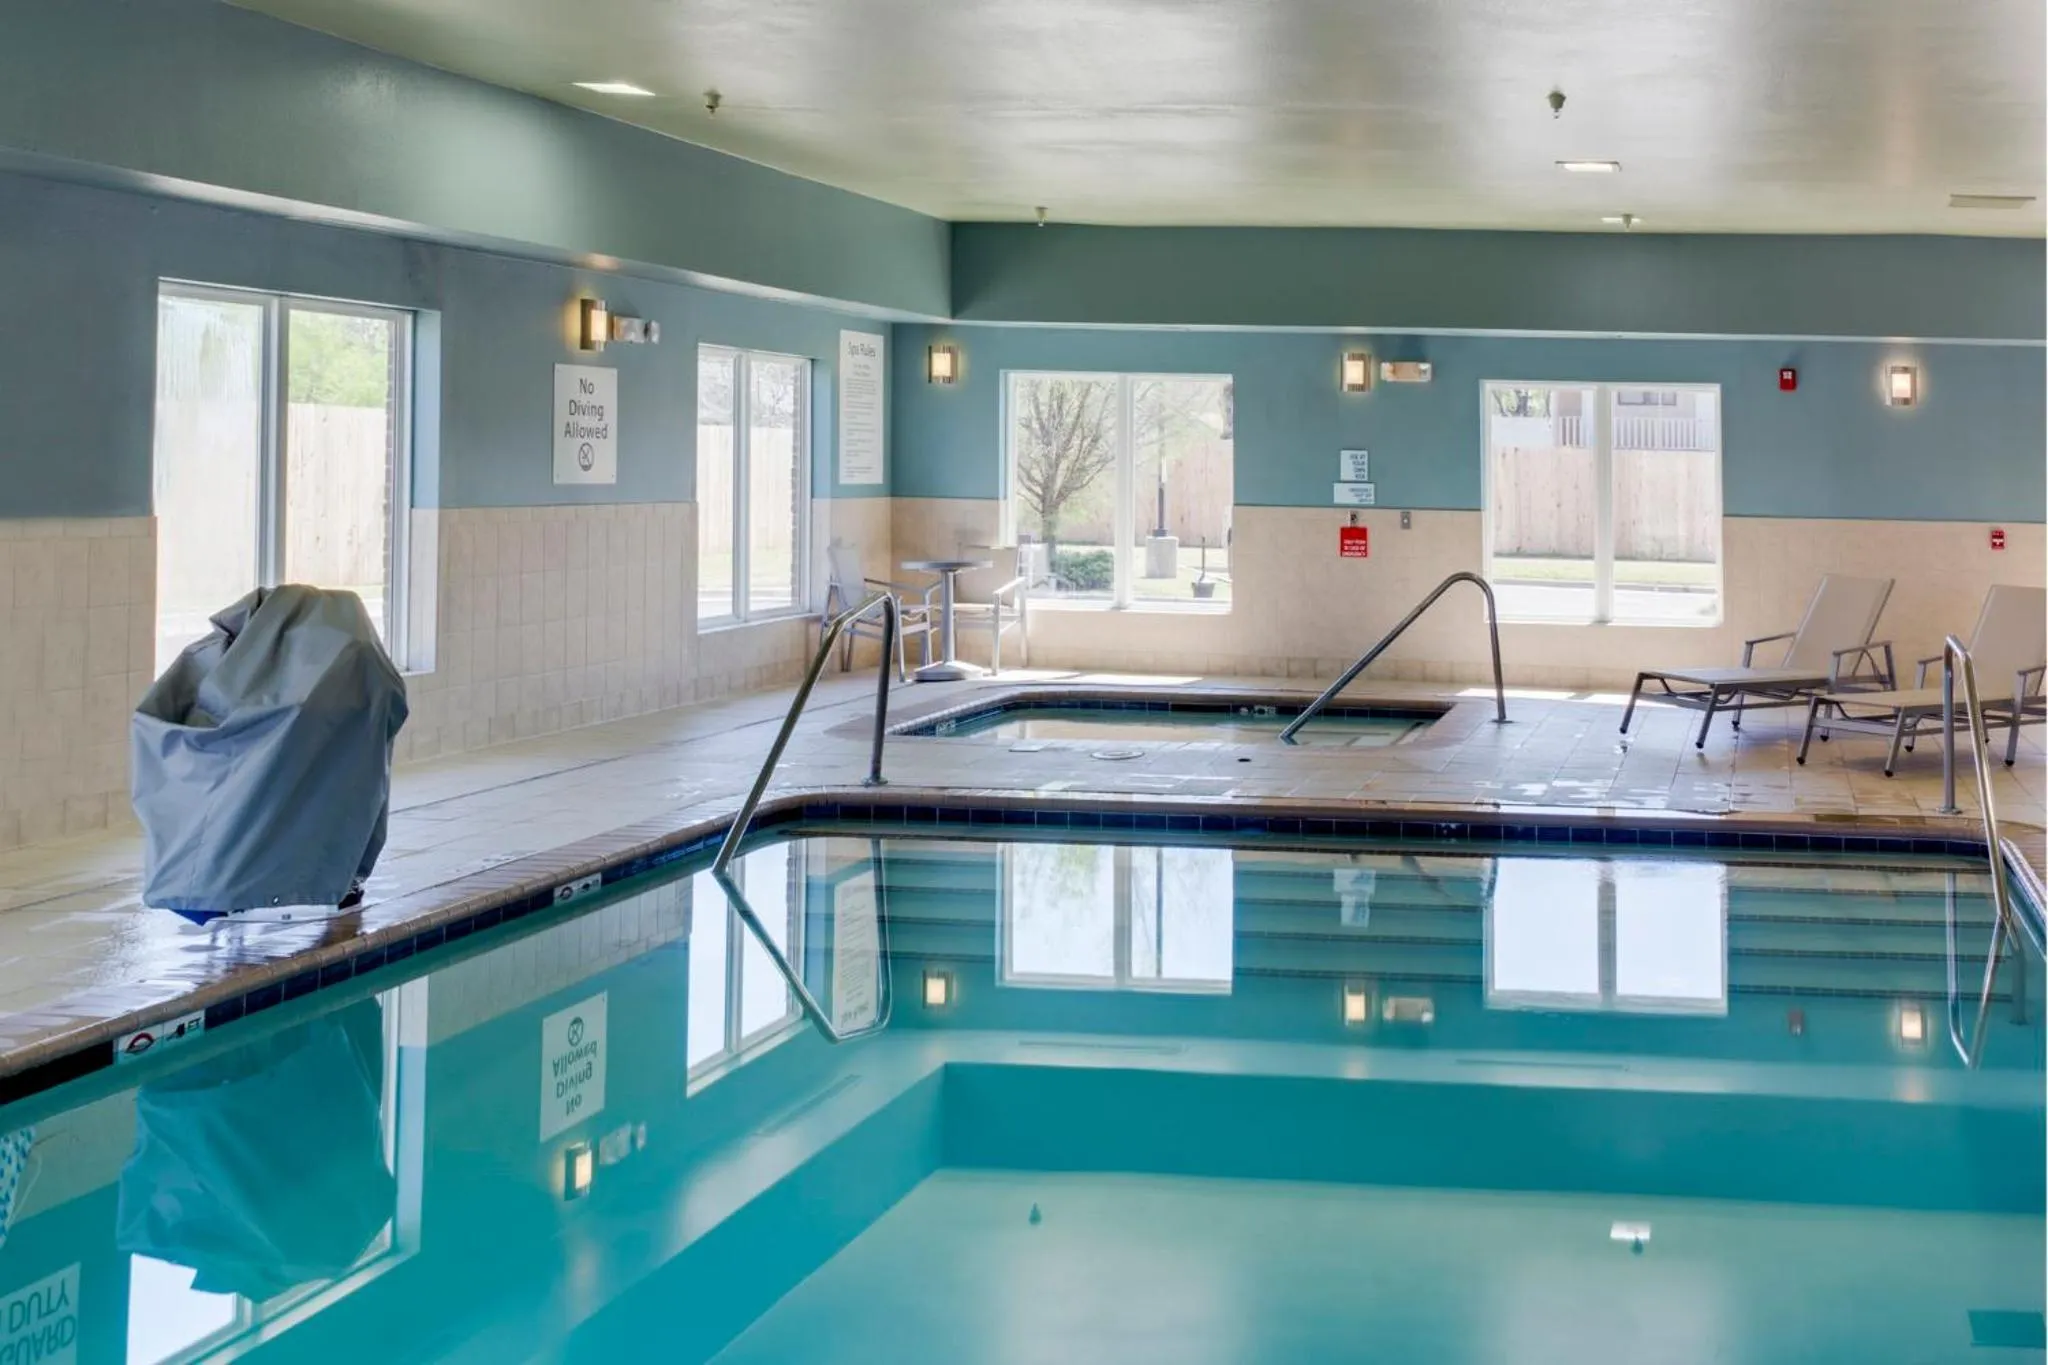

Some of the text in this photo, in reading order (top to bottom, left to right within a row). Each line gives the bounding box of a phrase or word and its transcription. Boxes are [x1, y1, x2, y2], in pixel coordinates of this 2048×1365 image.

[579, 377, 595, 395] No
[568, 399, 605, 421] Diving
[564, 421, 608, 440] Allowed
